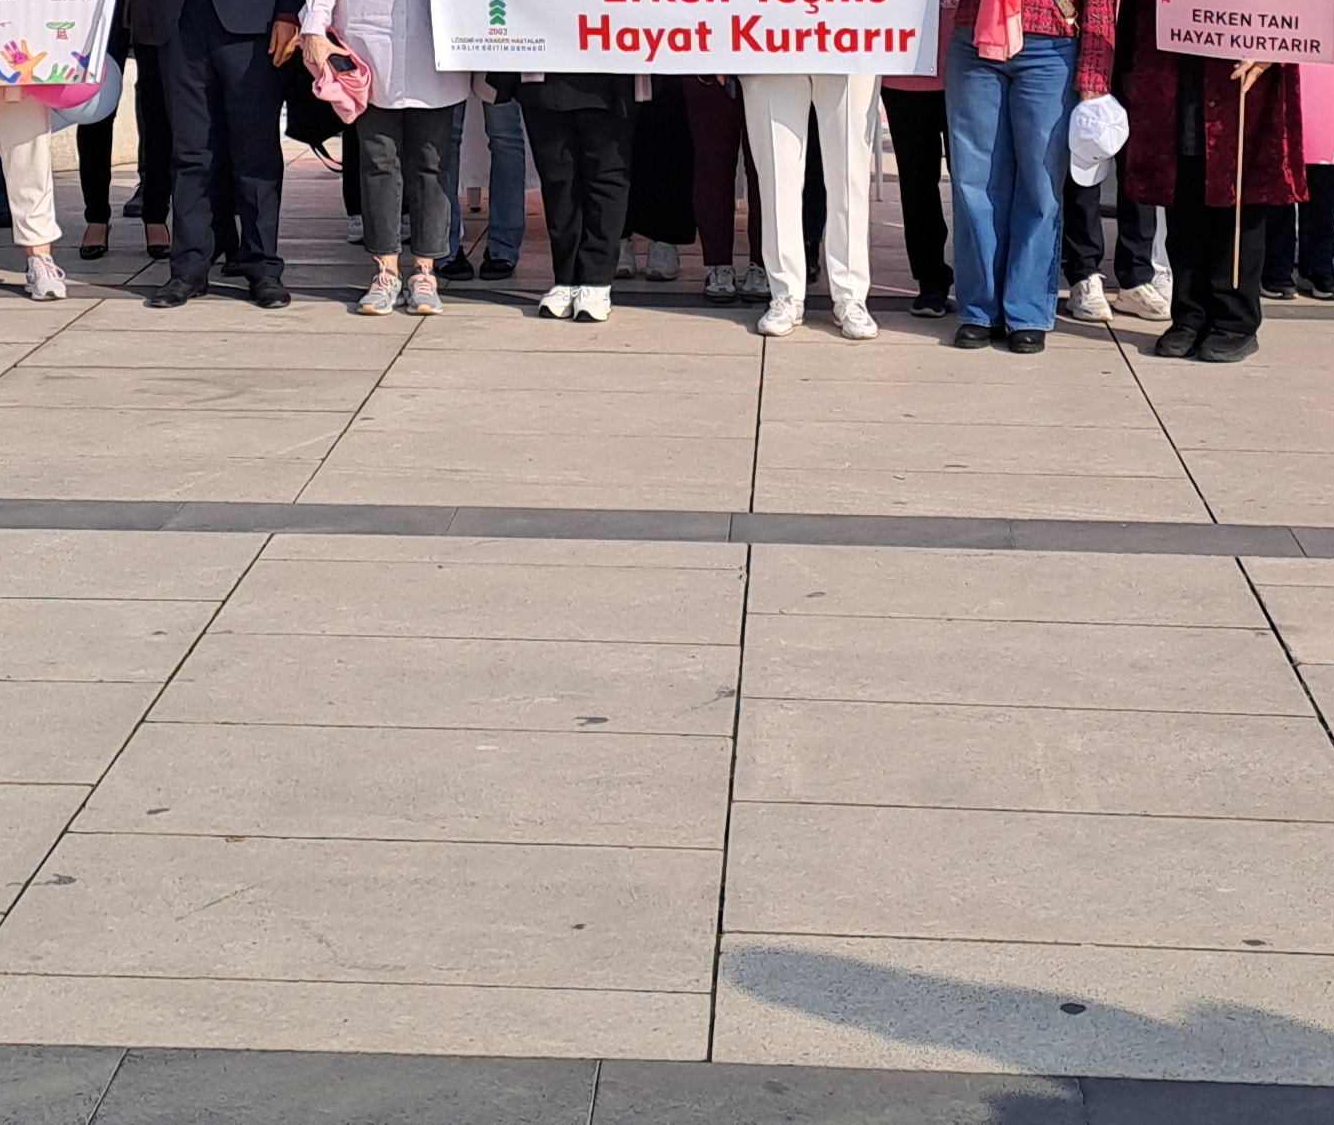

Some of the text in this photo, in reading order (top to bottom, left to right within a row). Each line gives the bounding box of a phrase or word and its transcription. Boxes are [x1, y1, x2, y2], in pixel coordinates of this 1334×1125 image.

[1191, 9, 1300, 31] ERKEN TANI
[577, 13, 917, 63] Hayat Kurtarır
[1170, 28, 1322, 54] HAYAT KURTARIR
